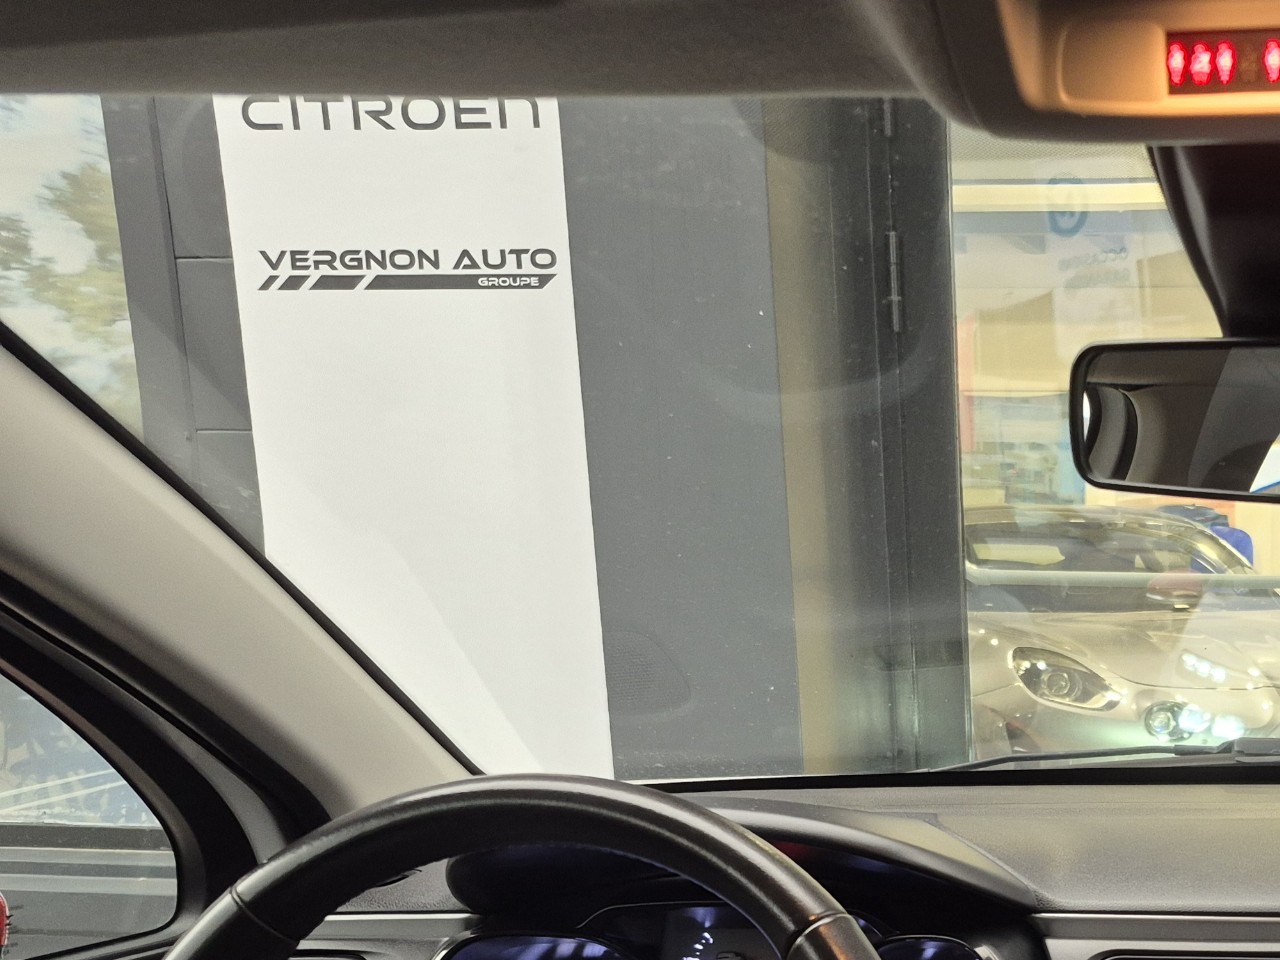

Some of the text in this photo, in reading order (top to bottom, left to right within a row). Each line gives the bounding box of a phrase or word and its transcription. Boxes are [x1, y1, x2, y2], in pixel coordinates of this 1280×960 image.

[258, 248, 558, 271] VERGNON AUTO
[477, 276, 540, 287] GROUPE
